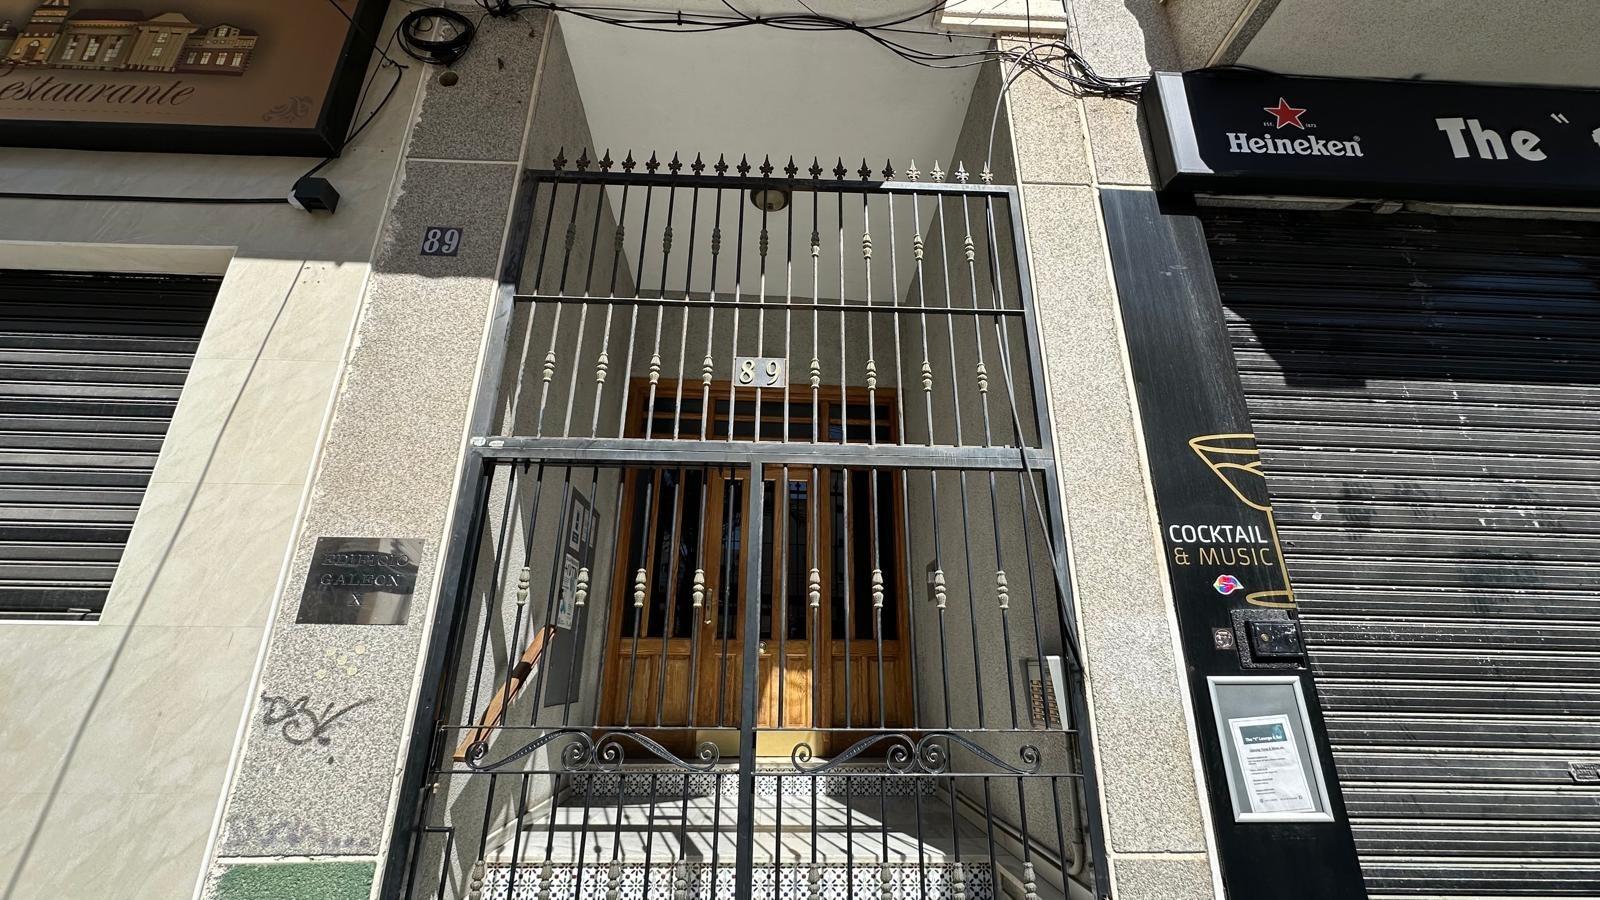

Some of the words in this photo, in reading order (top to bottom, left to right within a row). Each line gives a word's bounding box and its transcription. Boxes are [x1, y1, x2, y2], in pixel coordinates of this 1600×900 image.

[0, 68, 195, 106] estaurante
[1226, 132, 1364, 157] Heineken
[1435, 117, 1548, 162] The
[423, 229, 459, 253] 89
[739, 359, 781, 386] 89
[1169, 524, 1269, 544] COCKTAIL
[1174, 547, 1191, 565] &
[1199, 547, 1273, 566] MUSIC
